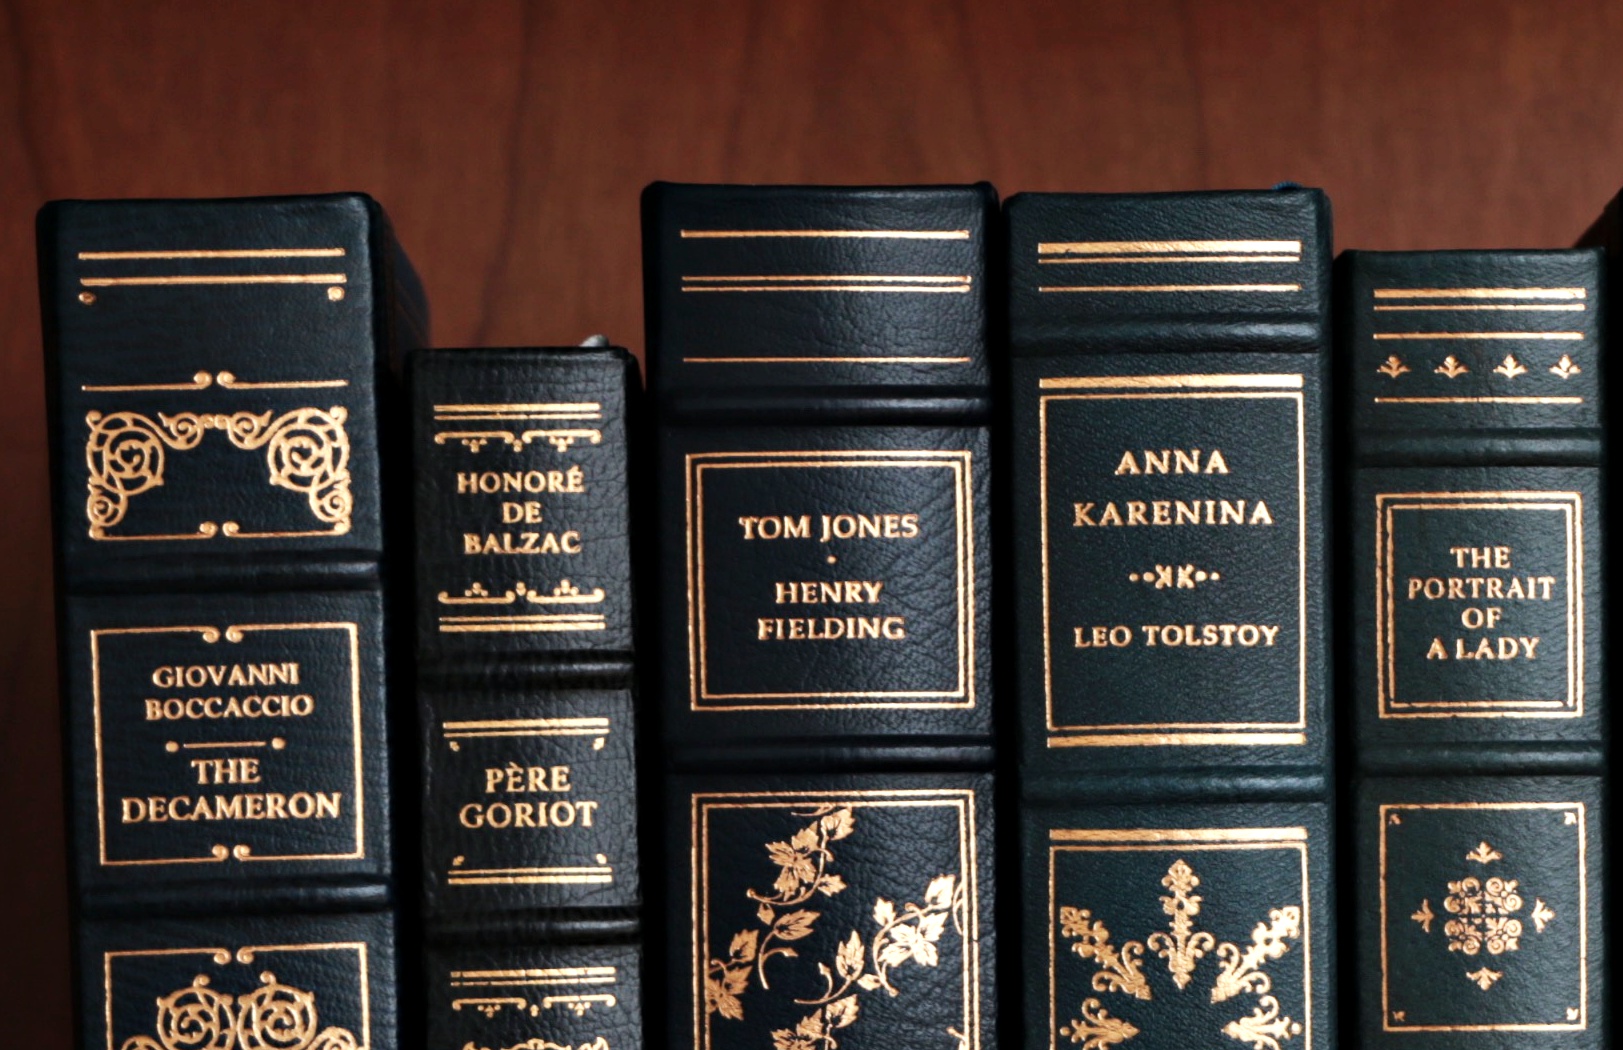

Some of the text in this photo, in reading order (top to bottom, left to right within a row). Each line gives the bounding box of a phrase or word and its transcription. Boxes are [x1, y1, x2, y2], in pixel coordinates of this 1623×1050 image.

[1114, 448, 1231, 476] ANNA
[457, 464, 587, 495] HONORÉ
[502, 500, 543, 524] DE
[1073, 499, 1275, 527] KARENINA
[463, 529, 582, 555] BALZAC
[738, 513, 921, 543] TOM JONES
[1449, 545, 1512, 570] THE
[775, 580, 884, 604] HENRY
[1408, 575, 1557, 601] PORTRAIT
[757, 616, 907, 641] FIELDING
[1461, 606, 1503, 630] OF
[1073, 623, 1280, 648] LEO TOLSTOY
[1426, 636, 1541, 661] A LADY
[151, 661, 300, 689] GIOVANNI
[144, 693, 315, 721] BOCCACCIO
[190, 757, 262, 785] THE
[485, 761, 572, 794] PÈRE
[121, 791, 343, 824] DECAMERON
[458, 799, 599, 829] GORIOT
